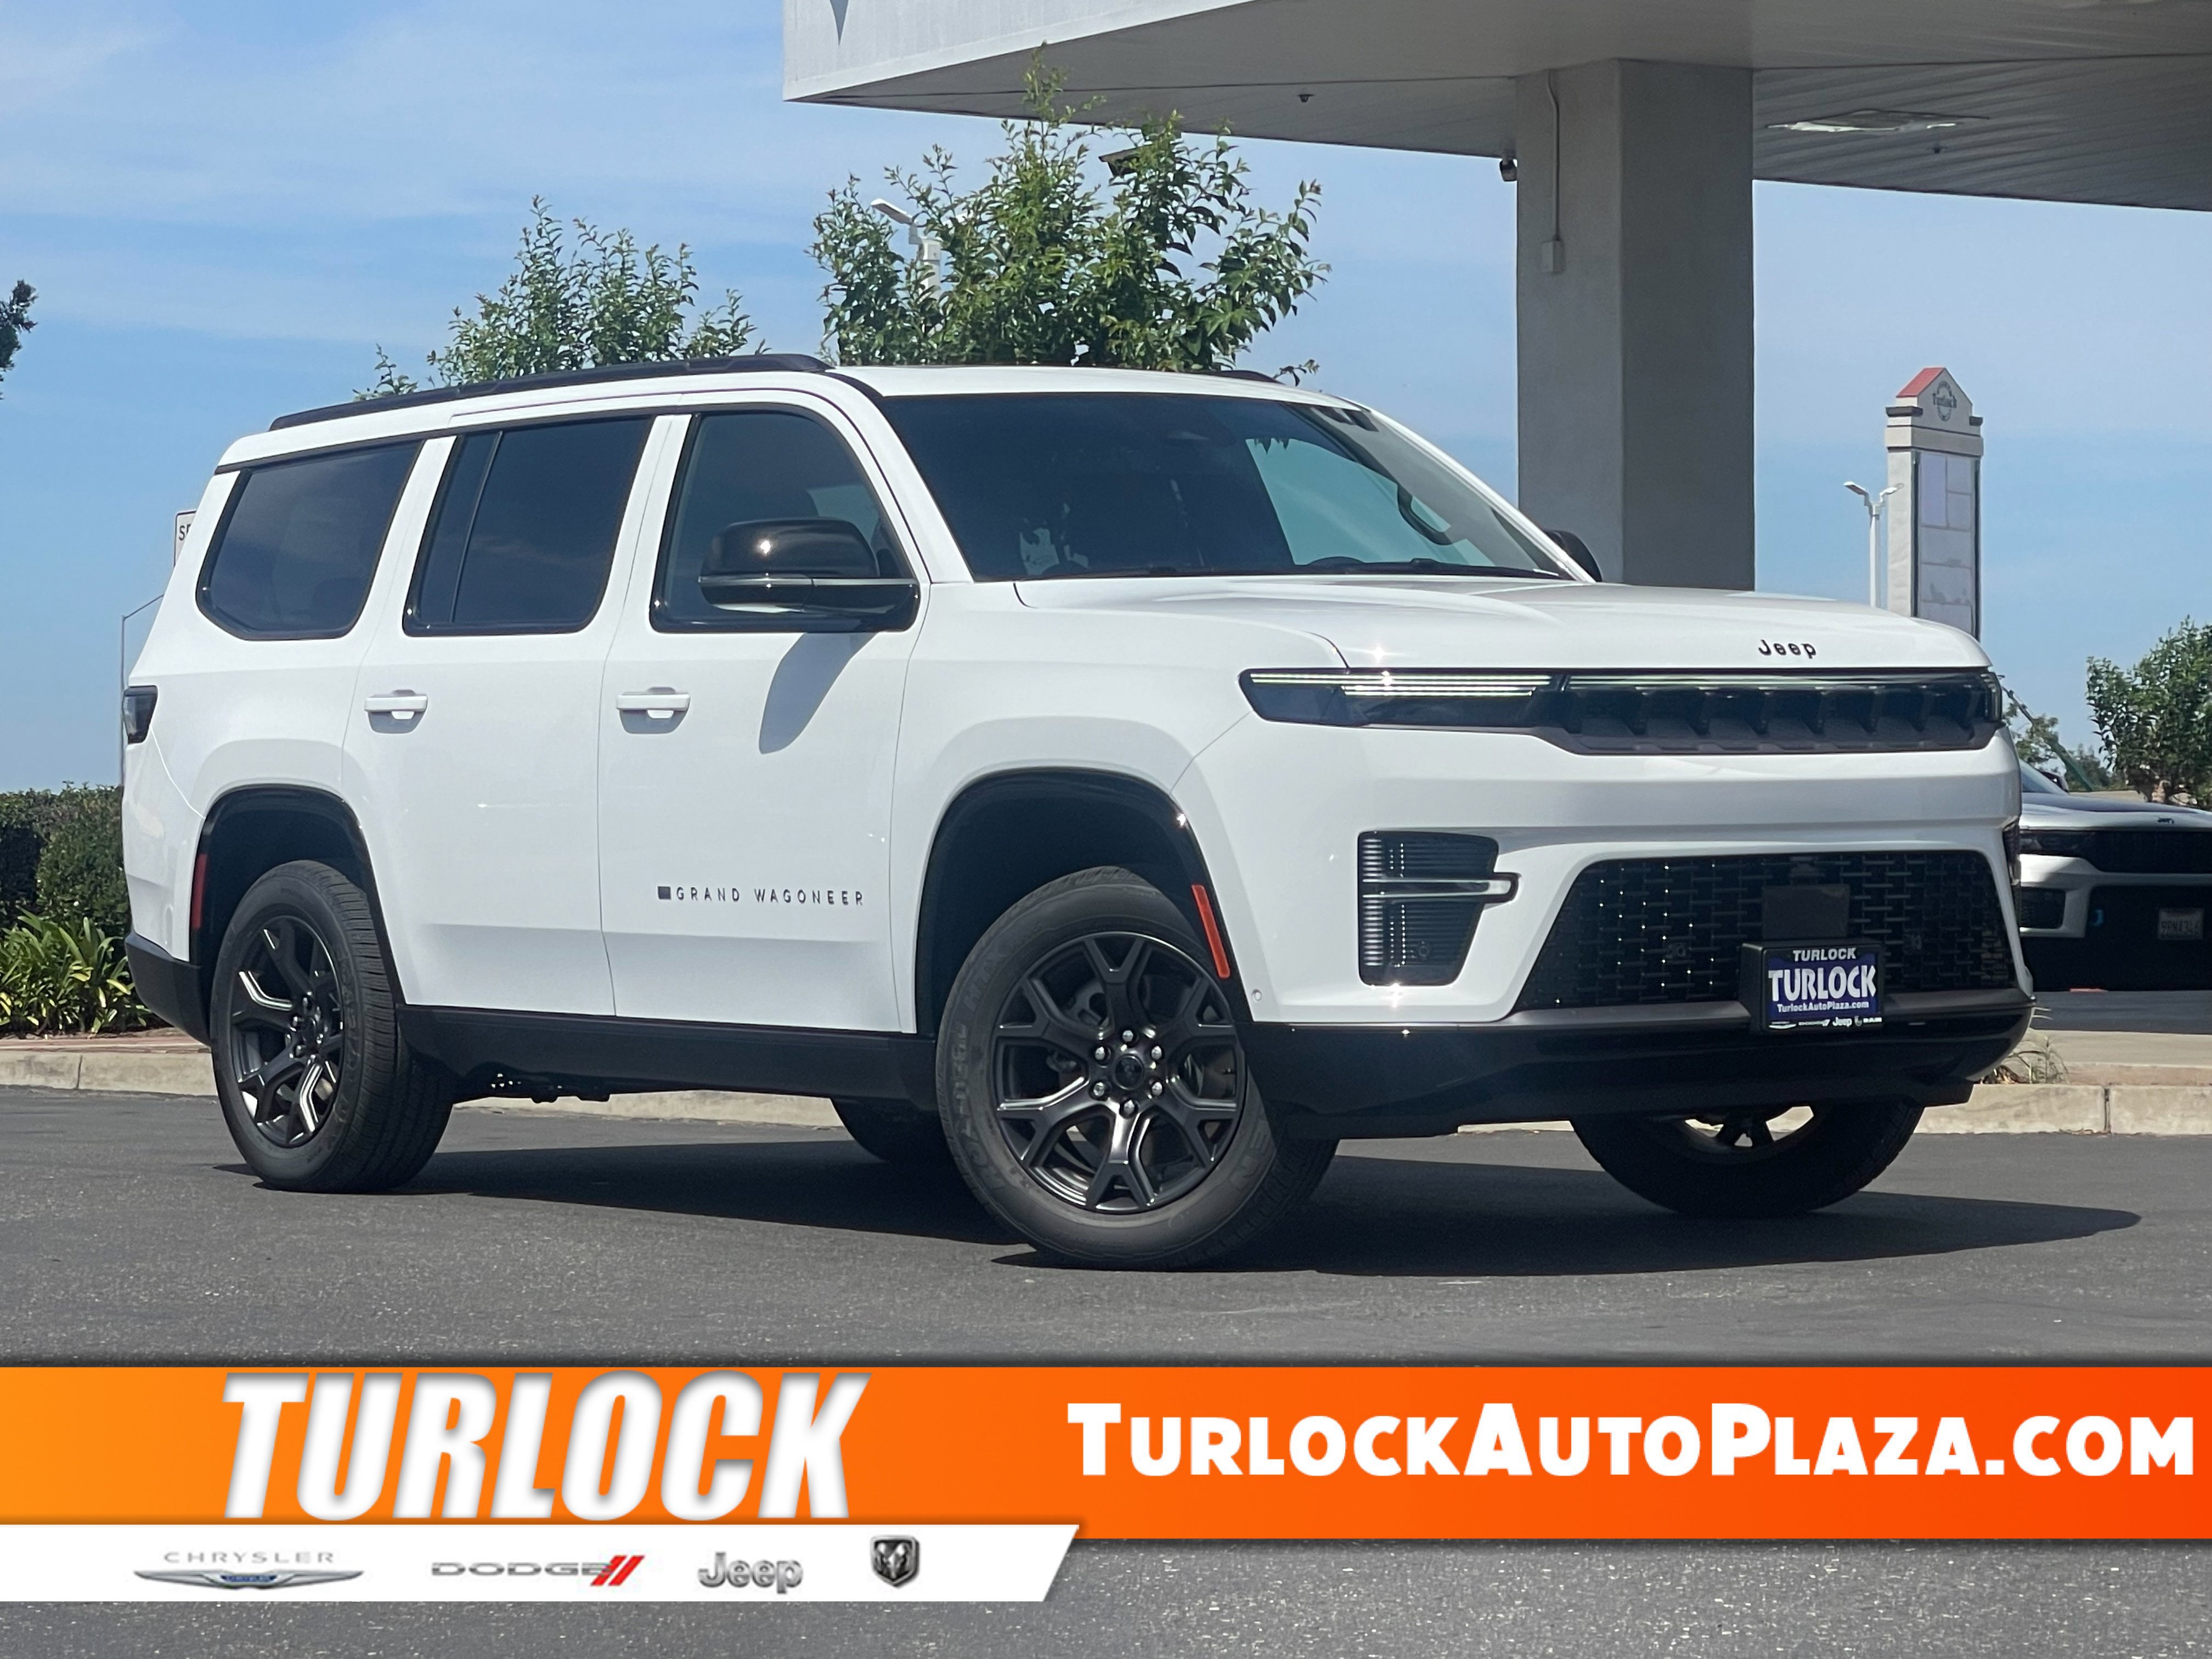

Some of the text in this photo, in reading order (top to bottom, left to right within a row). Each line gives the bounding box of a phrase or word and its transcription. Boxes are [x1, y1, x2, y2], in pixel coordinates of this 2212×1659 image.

[1758, 639, 1816, 659] Jeep
[676, 887, 864, 906] GRAND WAGONEER
[1793, 947, 1857, 961] TURLOCK
[1768, 965, 1876, 1002] TURLOCK
[1777, 1001, 1869, 1013] TurlockAutoPlaza.com
